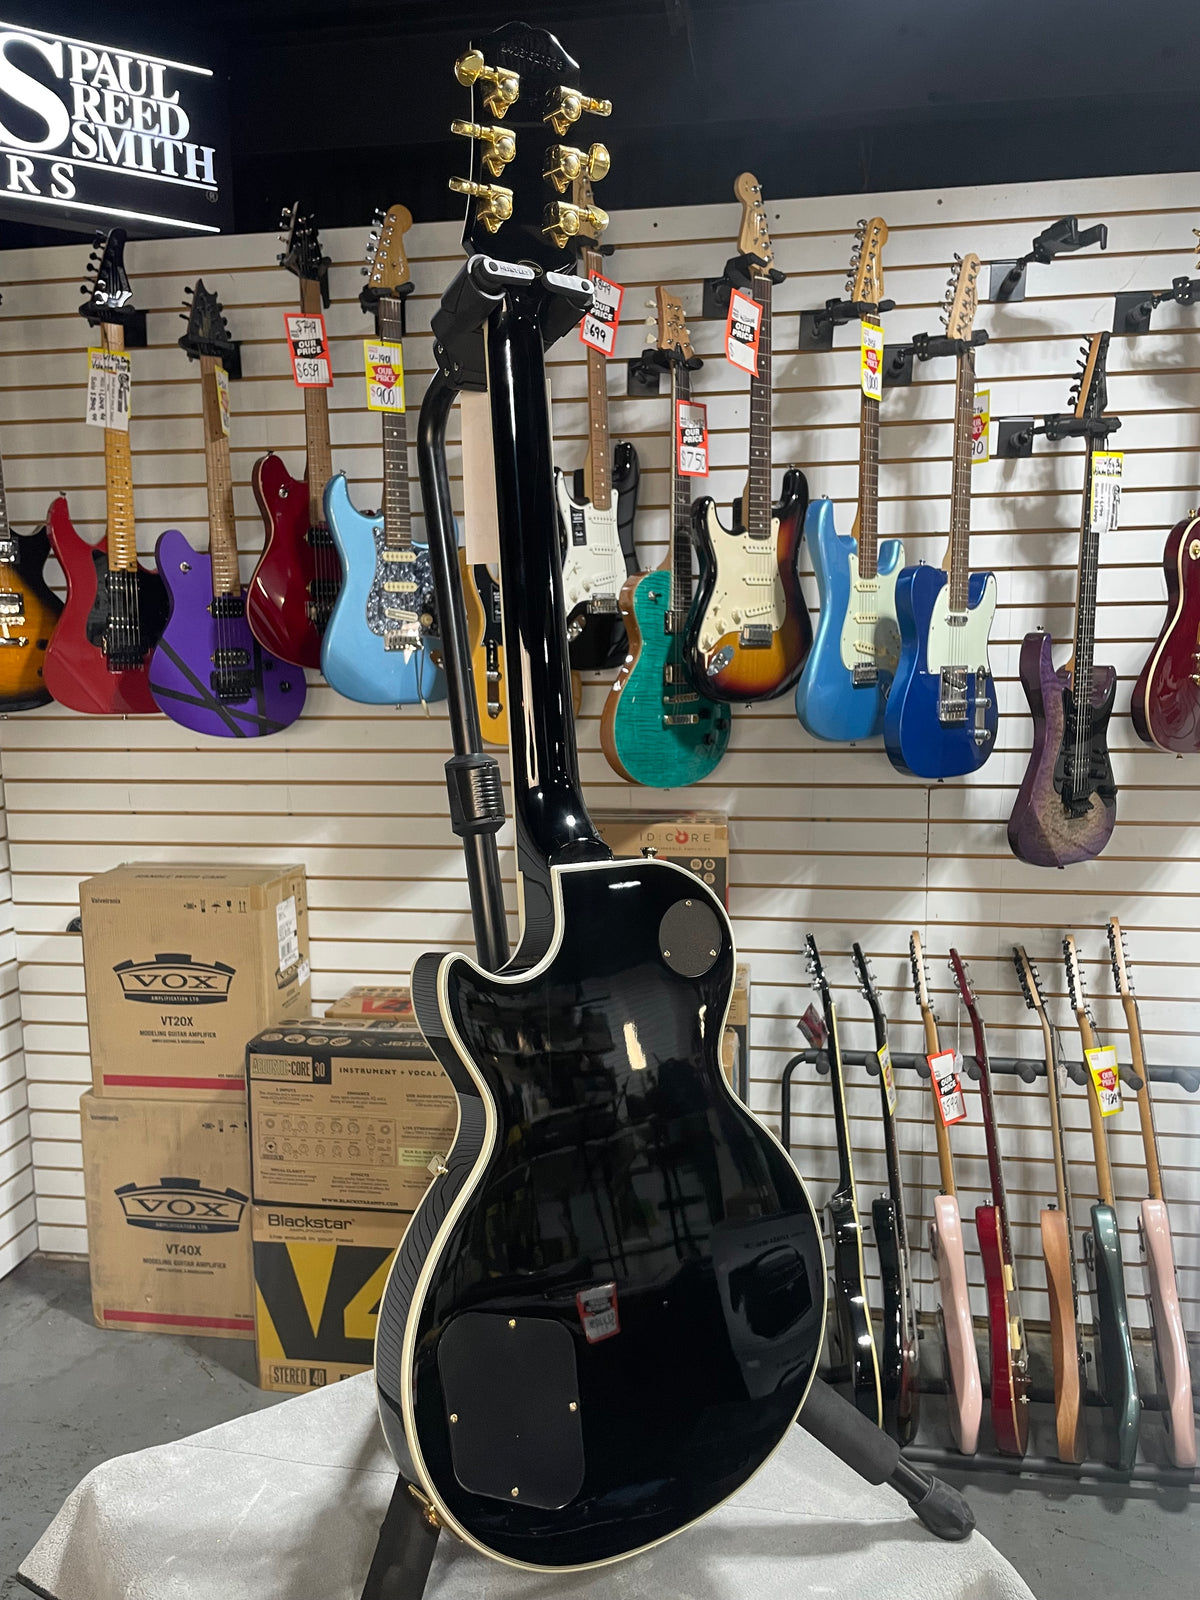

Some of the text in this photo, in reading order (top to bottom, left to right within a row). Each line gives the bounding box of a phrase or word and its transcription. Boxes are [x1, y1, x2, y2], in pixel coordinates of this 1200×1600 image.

[68, 44, 180, 105] PAUL
[70, 81, 190, 141] REED
[71, 120, 218, 185] SMITH
[594, 301, 611, 314] OUR
[590, 307, 614, 322] PRICE
[735, 321, 752, 334] OUR
[731, 328, 754, 343] PRICE
[296, 345, 322, 356] PRICE
[298, 340, 317, 349] OUR
[377, 366, 393, 376] OUR
[375, 374, 396, 383] PRICE
[684, 428, 701, 437] OUR
[683, 435, 704, 444] PRICE
[128, 973, 218, 989] VOX
[160, 1015, 194, 1027] VT20X
[314, 1061, 326, 1078] 30
[339, 1067, 397, 1076] INSTRUMENT
[408, 1068, 437, 1077] VOCAL
[131, 1198, 229, 1217] VOX
[267, 1214, 353, 1230] Blackstar
[166, 1243, 202, 1256] VT40X
[143, 1257, 173, 1266] MODELING
[196, 1261, 227, 1269] AMPLIFIER
[273, 1366, 325, 1386] STEREO 40
